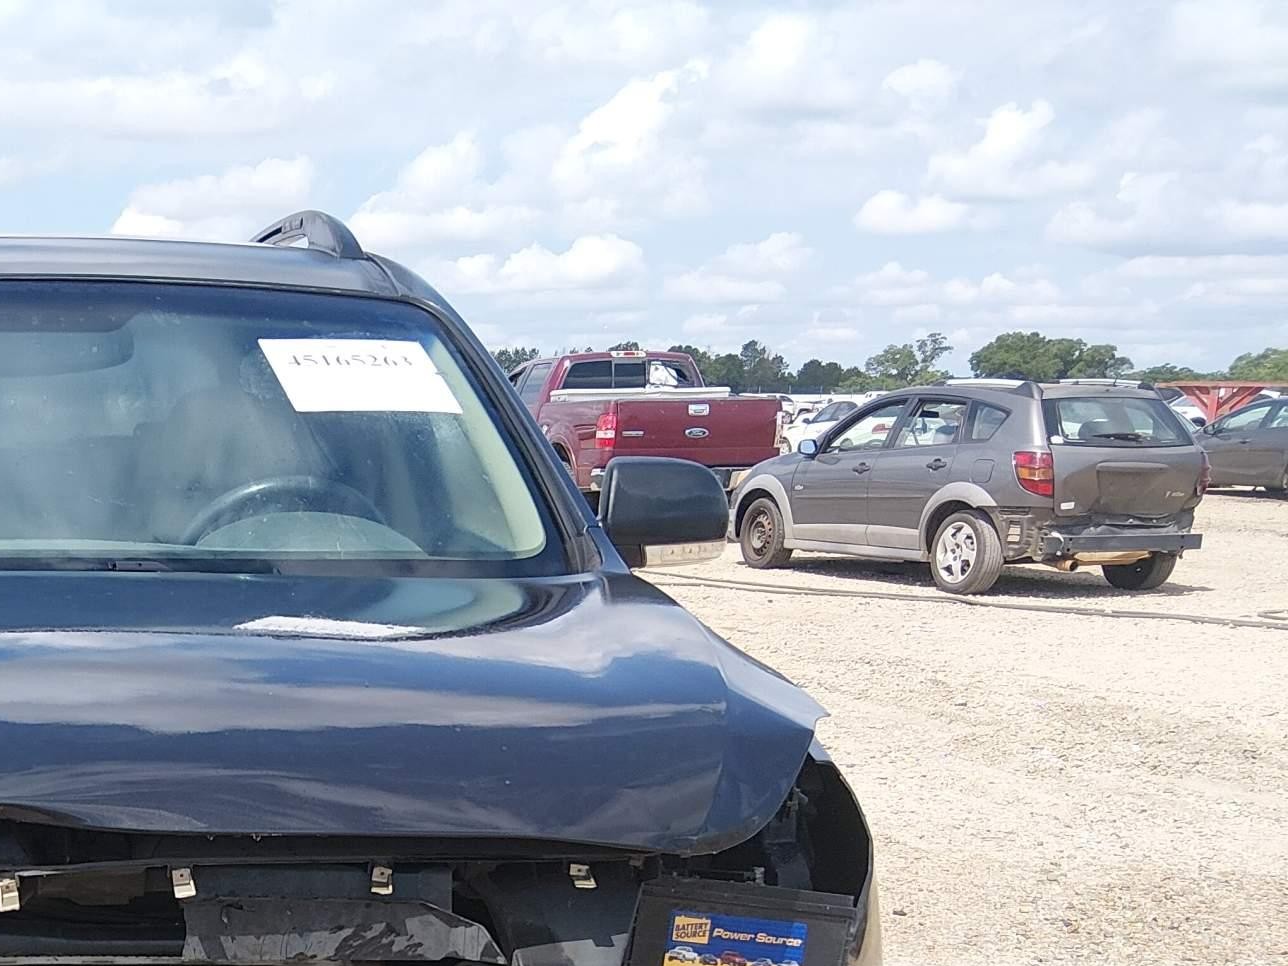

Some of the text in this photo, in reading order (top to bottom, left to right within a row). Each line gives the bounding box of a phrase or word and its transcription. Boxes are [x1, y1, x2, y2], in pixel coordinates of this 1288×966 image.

[674, 930, 707, 939] SOURCE
[712, 928, 802, 946] Power Source
